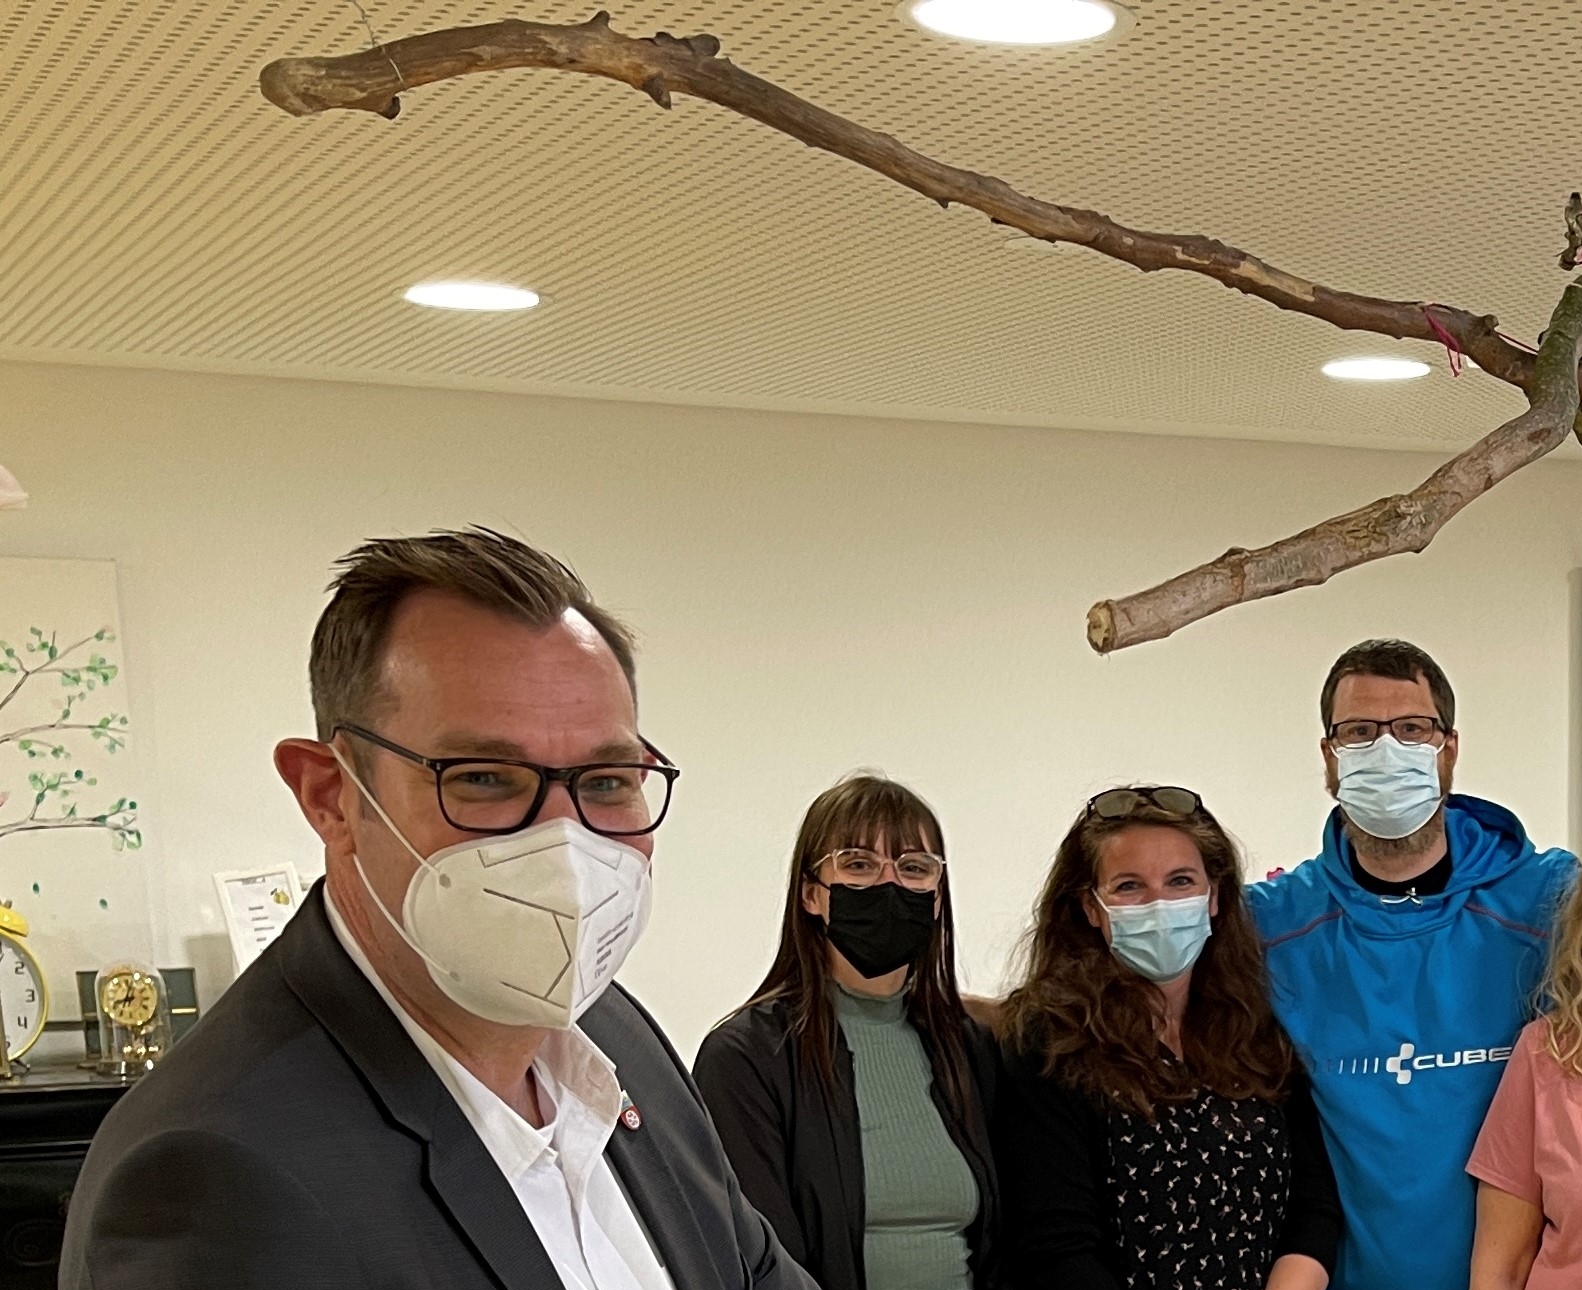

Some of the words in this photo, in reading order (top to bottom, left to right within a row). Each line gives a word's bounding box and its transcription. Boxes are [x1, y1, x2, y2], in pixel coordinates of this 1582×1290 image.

[14, 961, 25, 975] 2
[25, 988, 35, 1003] 3
[17, 1015, 28, 1029] 4
[1412, 1046, 1513, 1070] CUBE
